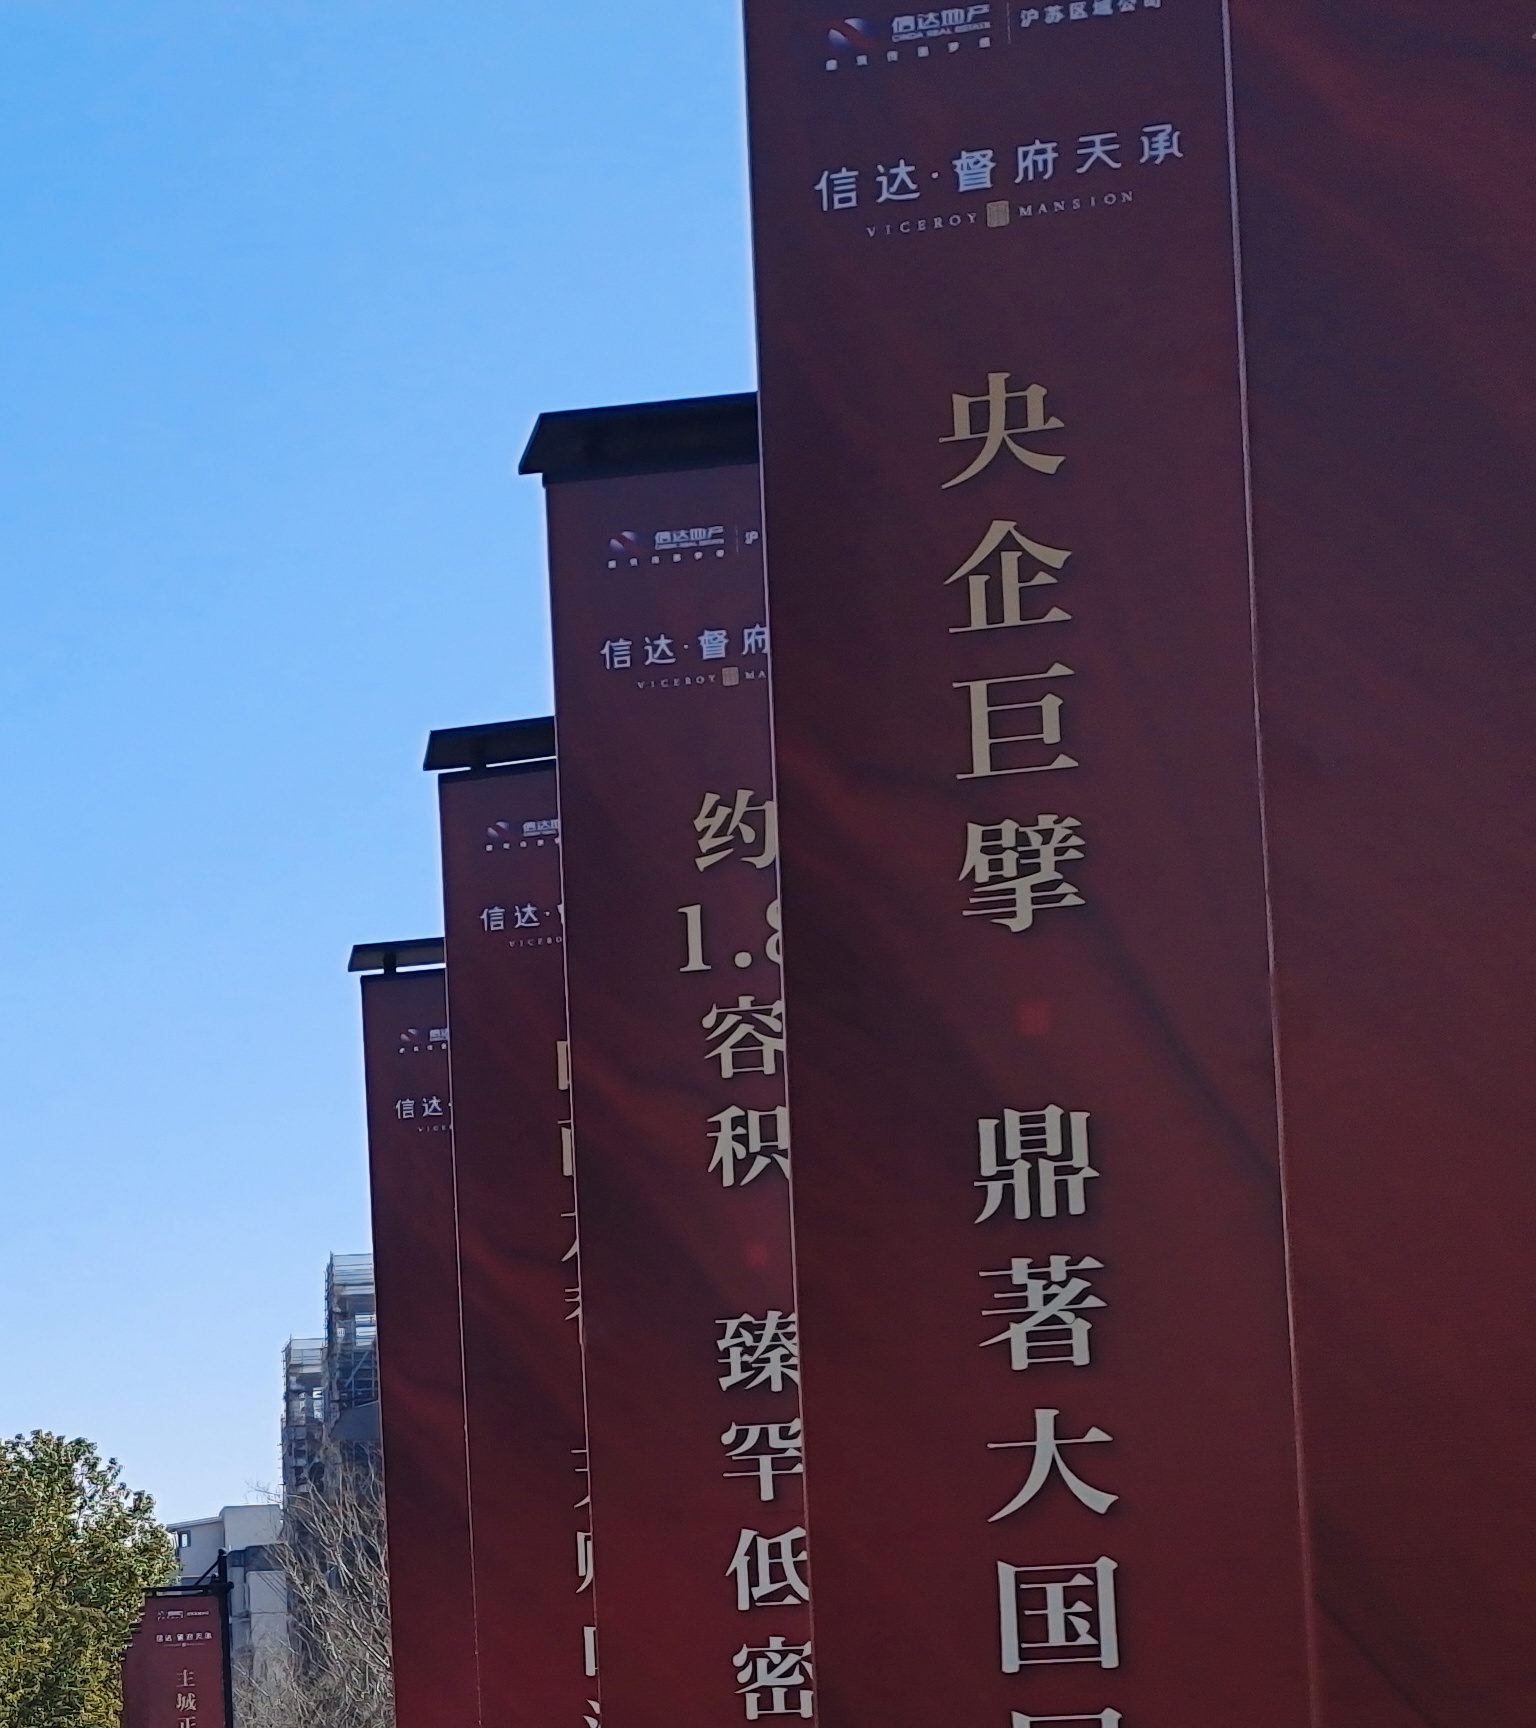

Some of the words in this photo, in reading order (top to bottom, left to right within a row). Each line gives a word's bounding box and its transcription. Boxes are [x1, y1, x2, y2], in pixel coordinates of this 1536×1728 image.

[866, 211, 978, 238] VICEROY
[1019, 190, 1134, 218] MANSION
[938, 371, 1086, 933] 央企巨擘
